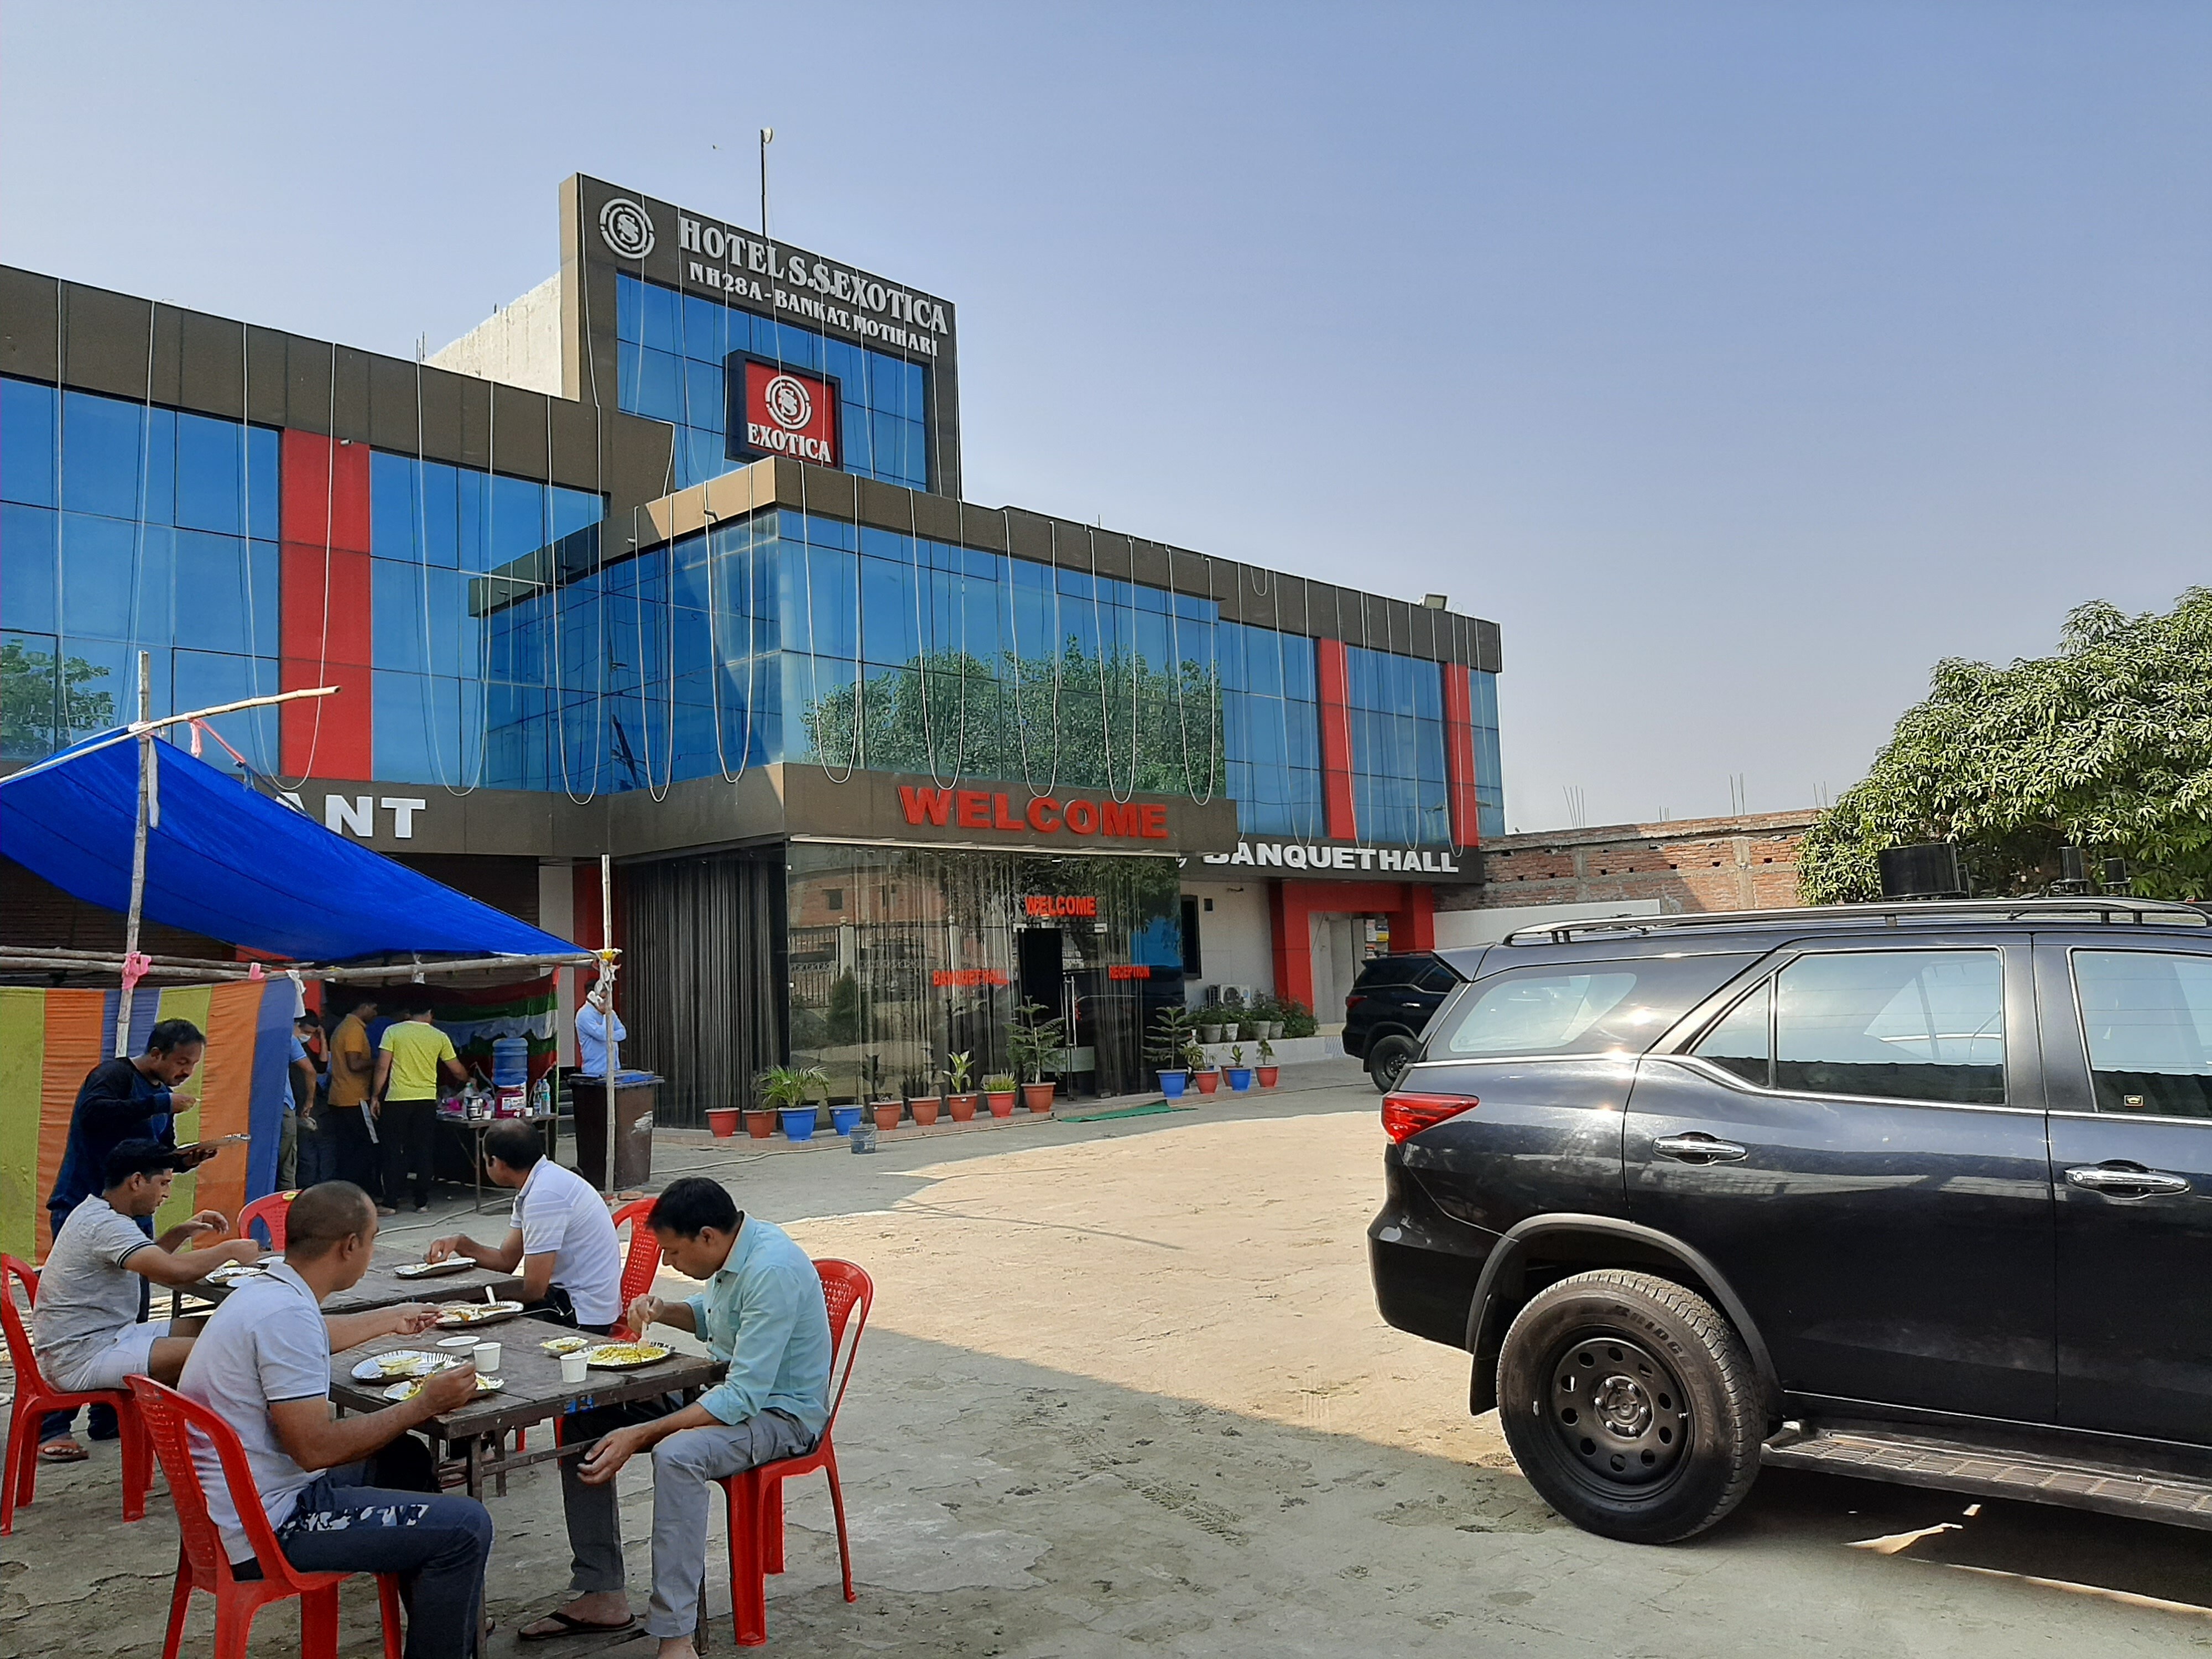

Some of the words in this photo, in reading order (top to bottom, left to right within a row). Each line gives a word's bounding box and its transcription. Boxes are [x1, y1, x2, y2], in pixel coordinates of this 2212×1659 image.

[679, 216, 784, 279] HOTEL
[747, 422, 832, 463] EXOTICA
[898, 785, 1168, 838] WELCOME
[1025, 896, 1097, 917] WELCOME
[1108, 965, 1151, 979] RECEPTION
